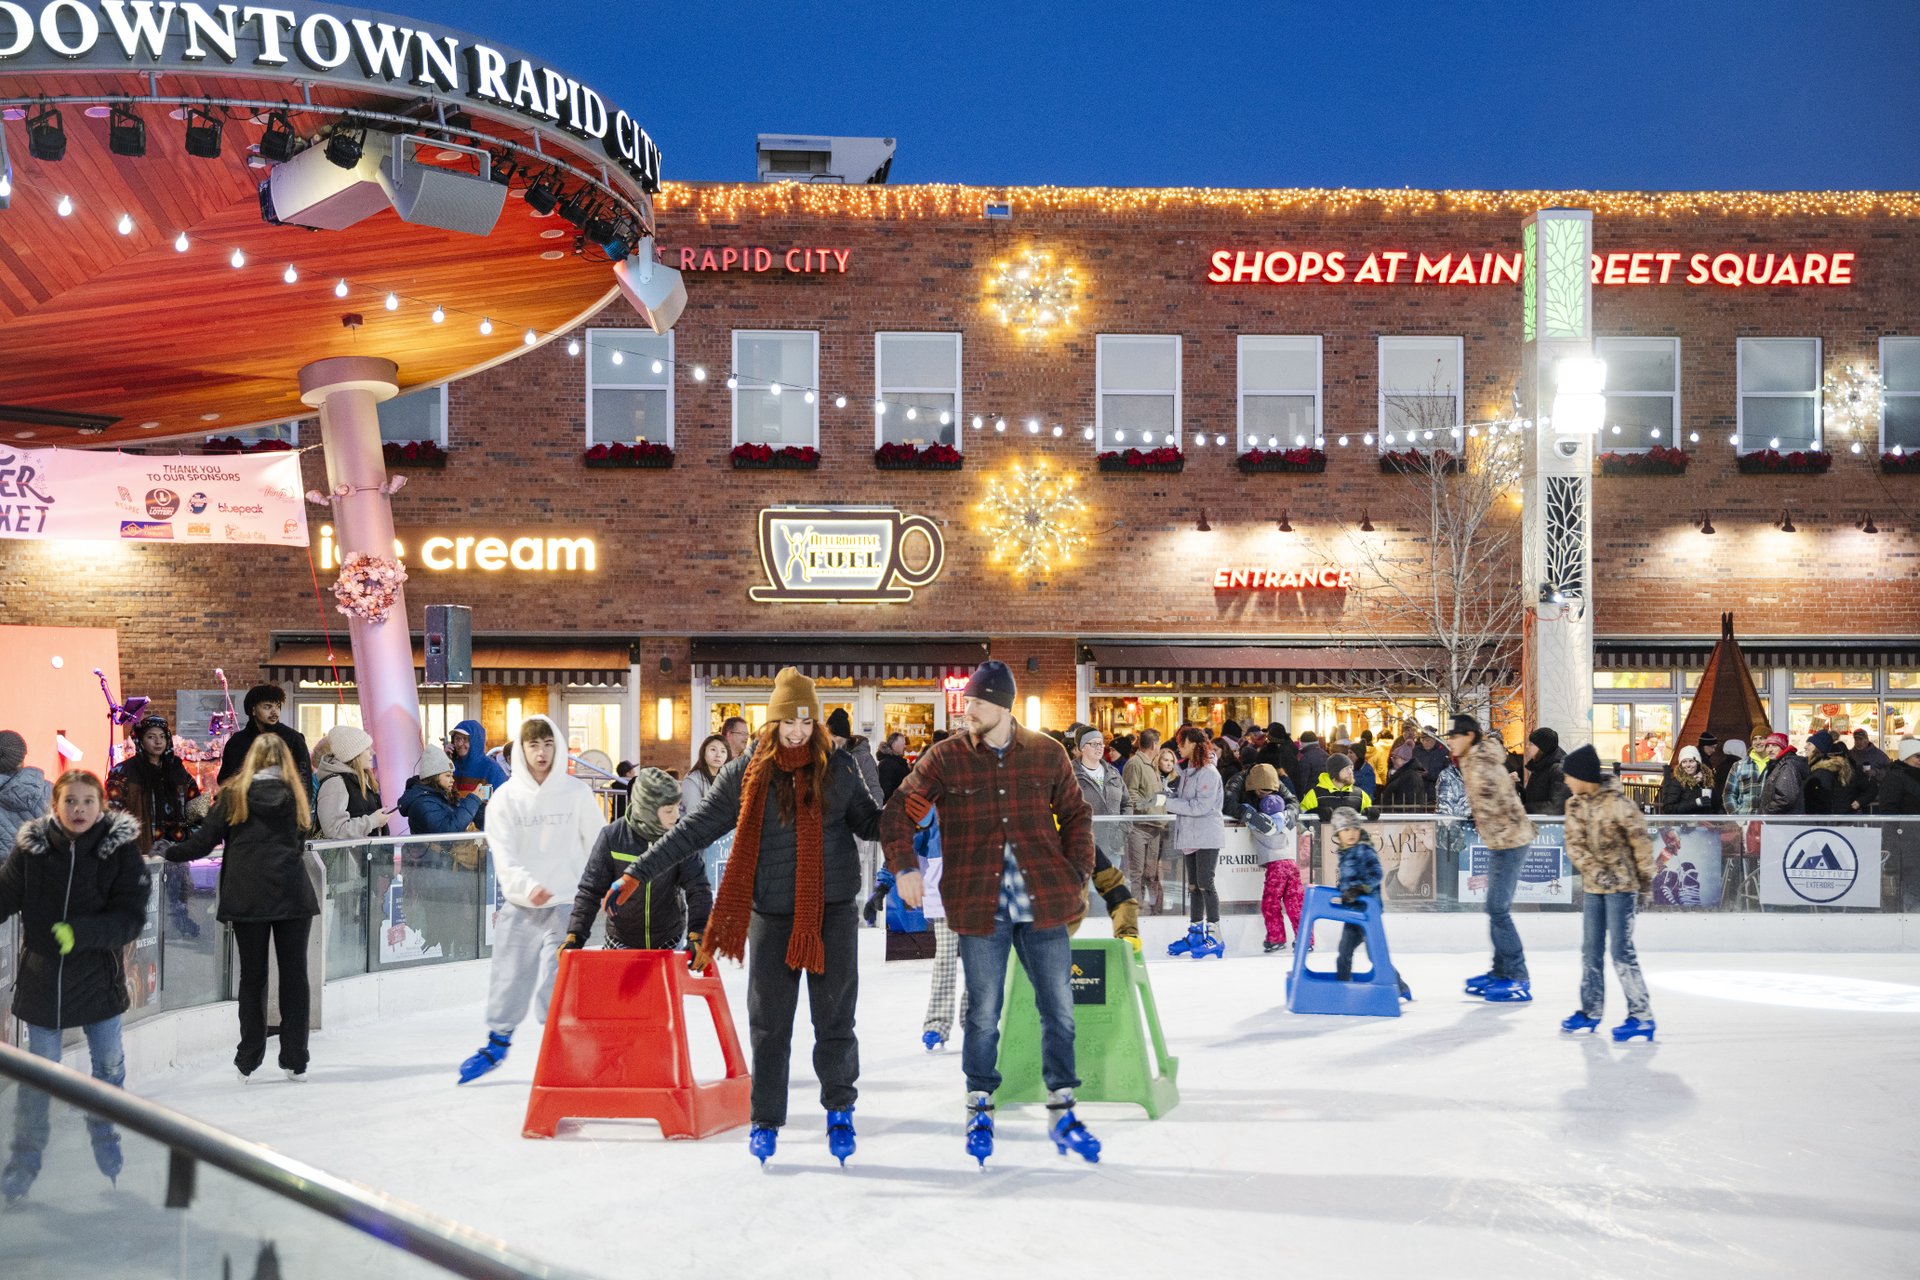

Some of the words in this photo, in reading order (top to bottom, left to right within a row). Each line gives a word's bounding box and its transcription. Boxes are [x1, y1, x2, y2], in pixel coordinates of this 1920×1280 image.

[0, 0, 459, 89] DOWNTOWN
[474, 44, 608, 139] RAPID
[616, 109, 663, 193] CITY
[680, 247, 773, 273] RAPID
[785, 248, 851, 273] CITY
[1207, 250, 1346, 283] SHOPS
[1353, 251, 1409, 283] AT
[1414, 252, 1523, 284] MAIN
[1590, 253, 1681, 284] REET
[1687, 253, 1856, 287] SQUARE
[146, 473, 161, 482] TO
[163, 474, 186, 482] OUR
[187, 473, 241, 482] SPONSORS
[163, 464, 198, 474] THANK
[199, 465, 221, 474] YOU
[218, 503, 263, 515] bluepeak
[421, 536, 596, 571] cream
[809, 551, 880, 568] FUEL
[1213, 567, 1354, 589] ENTRANCE
[1791, 870, 1850, 878] EXECUTIVE
[1805, 881, 1835, 889] EXTERIORS
